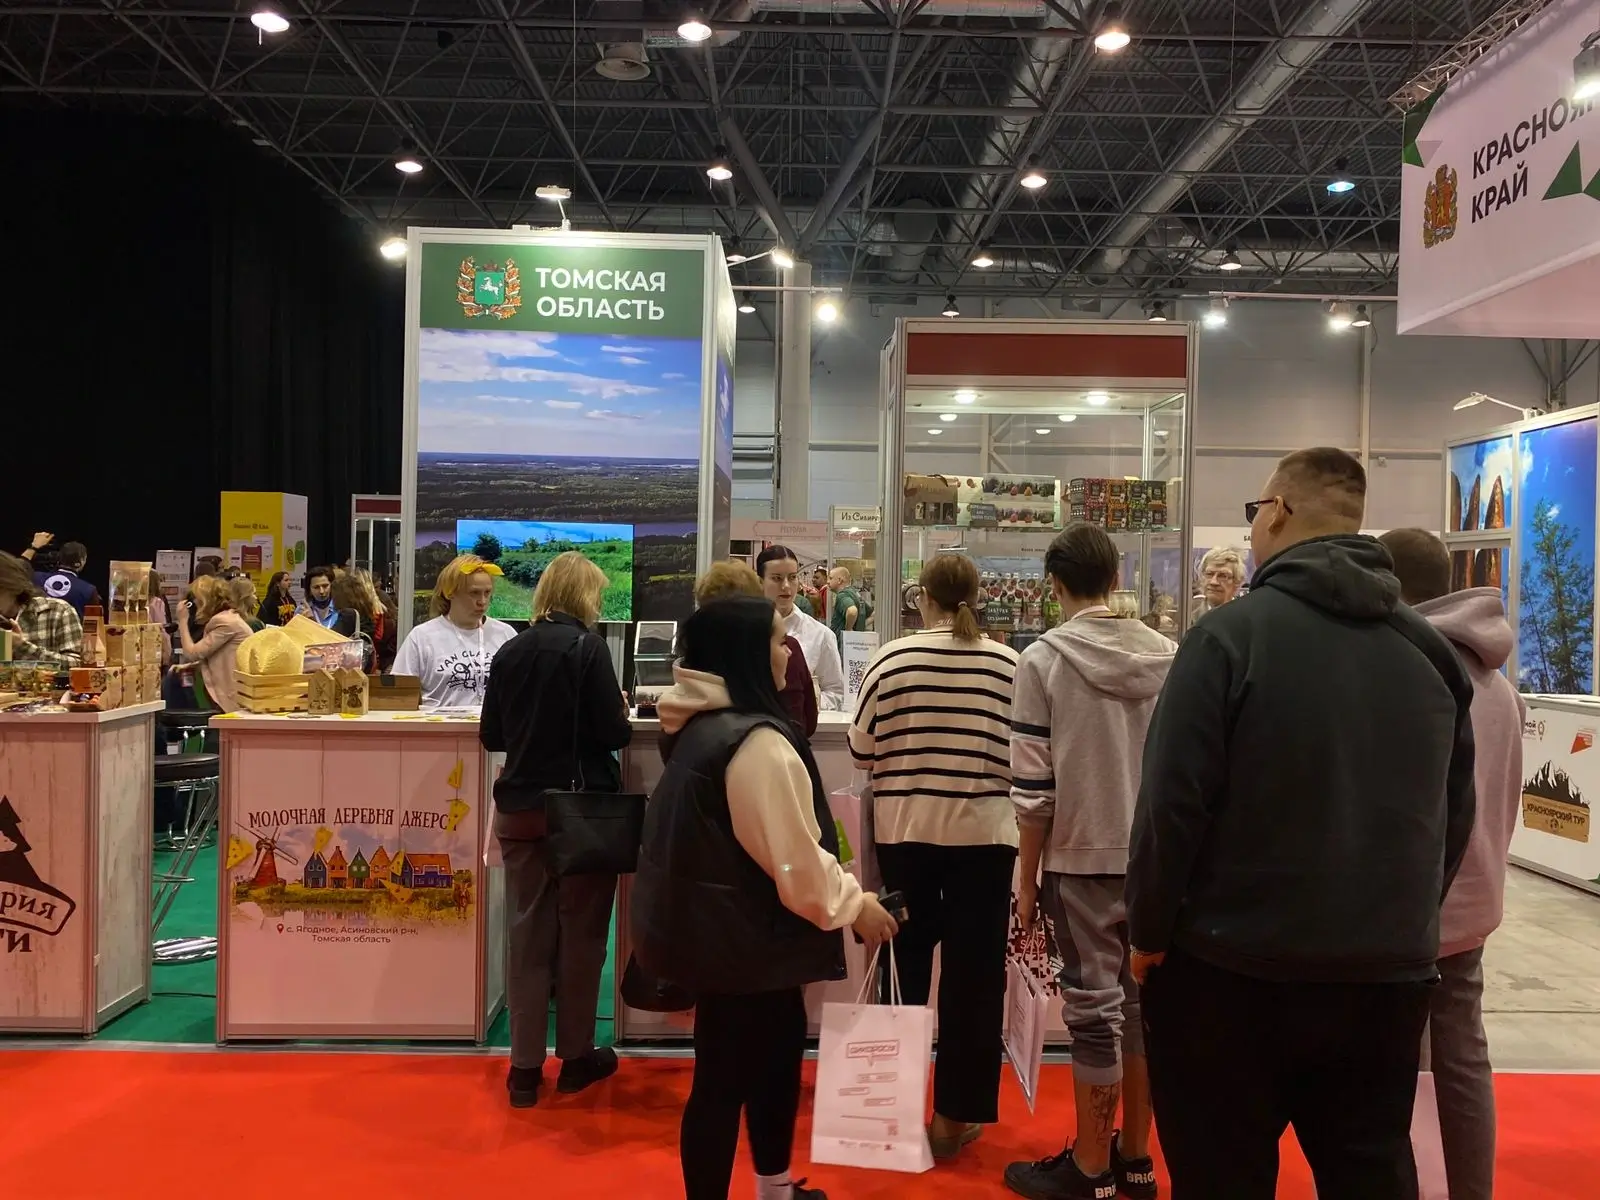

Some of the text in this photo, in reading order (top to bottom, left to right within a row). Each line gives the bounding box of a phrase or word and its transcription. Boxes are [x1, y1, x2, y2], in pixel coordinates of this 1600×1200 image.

[1471, 160, 1529, 224] КРАЙ
[535, 267, 666, 292] ТОМСКАЯ
[536, 296, 665, 321] ОБЛАСТЬ
[248, 807, 457, 832] МОЛОЧНАЯ ДЕРЕВНЯ ДЖЕРС
[296, 925, 339, 935] Ягодное,
[340, 924, 398, 934] Асиновский
[312, 934, 391, 943] Томская область
